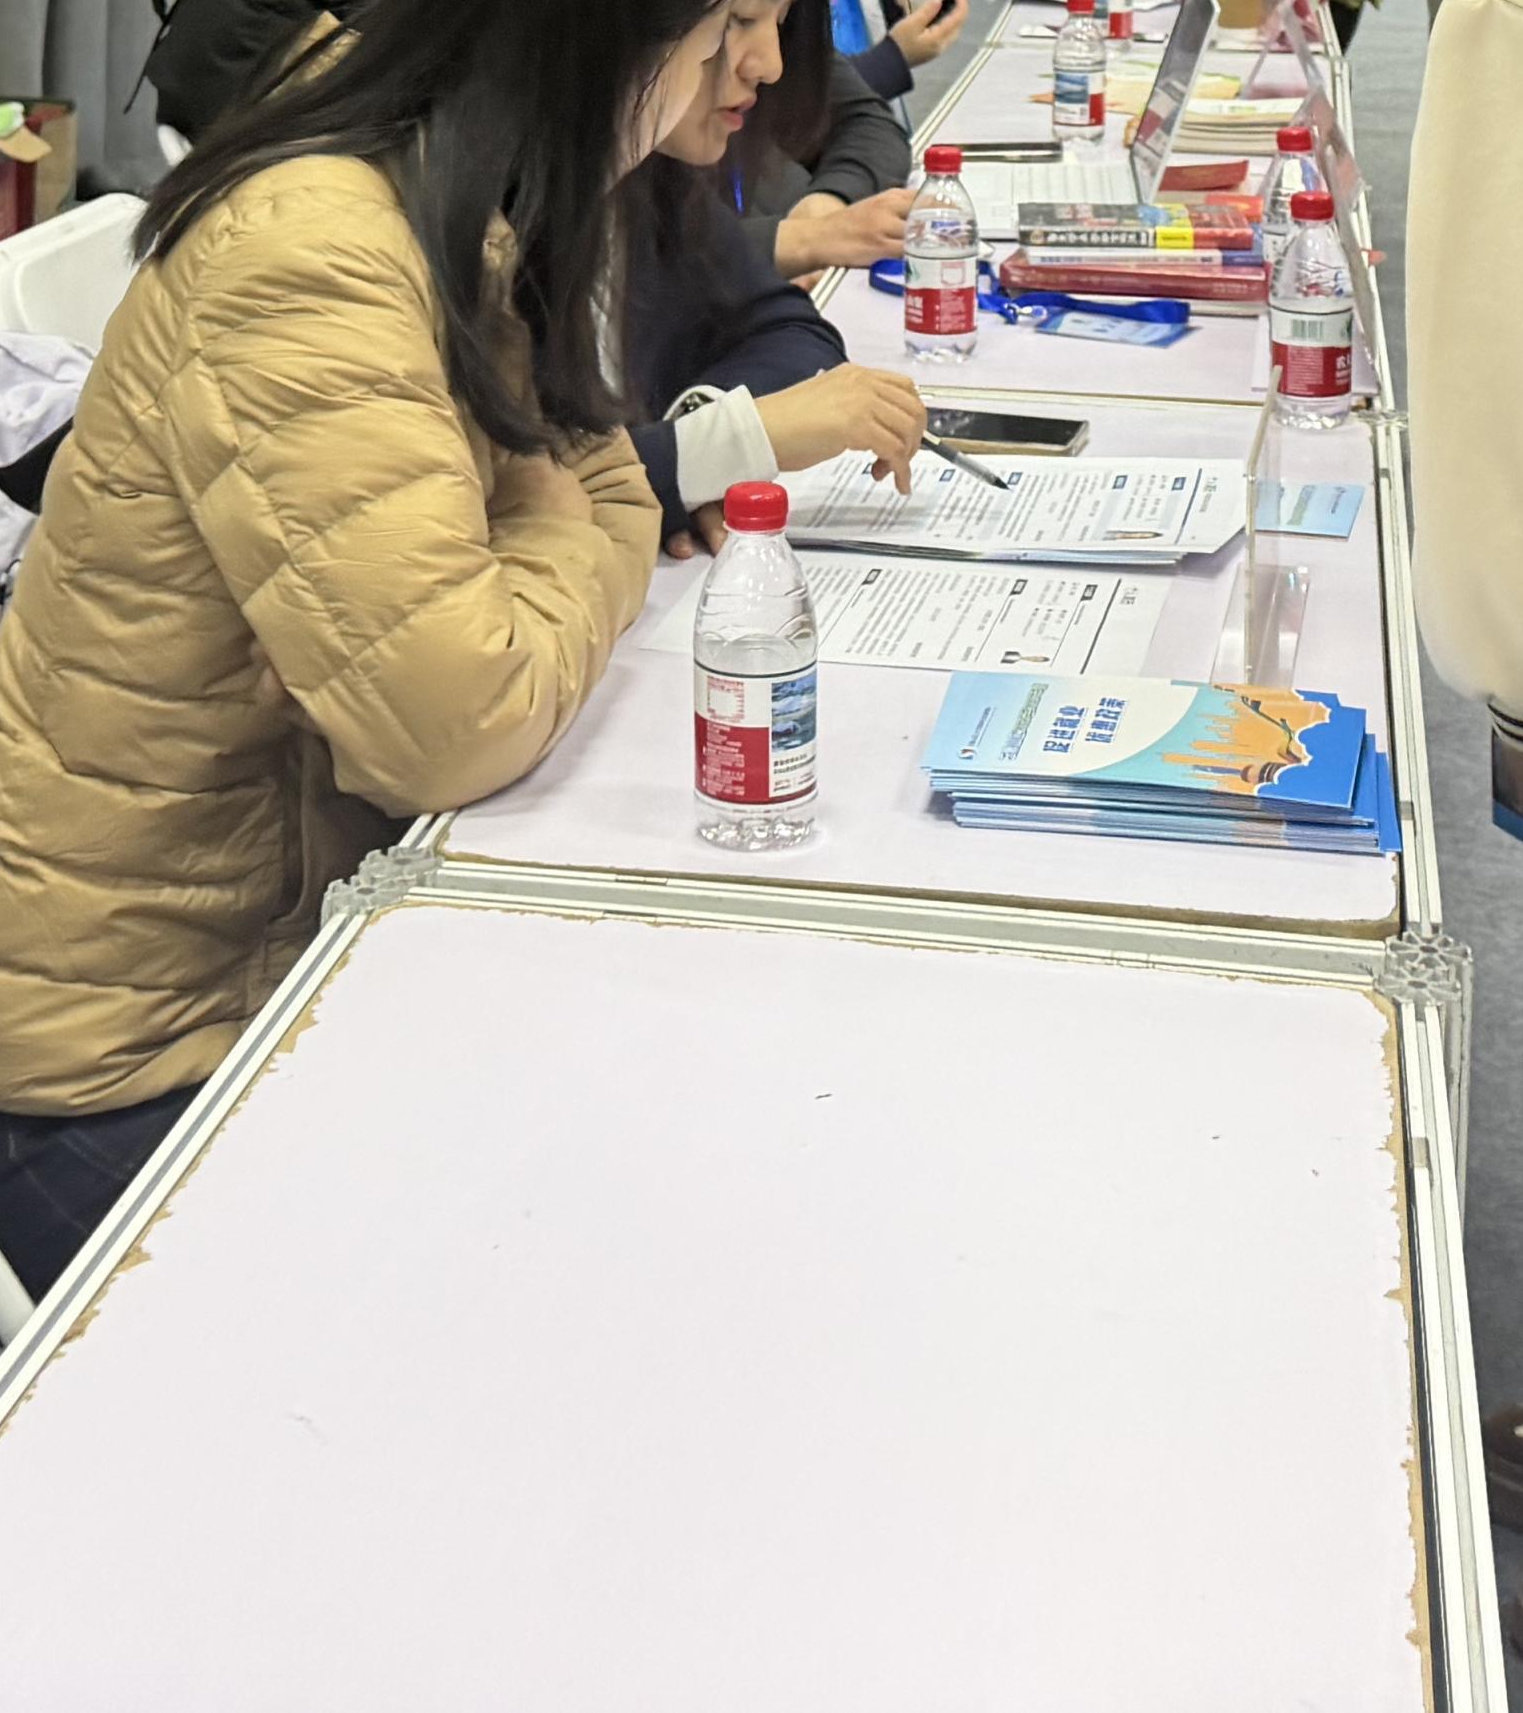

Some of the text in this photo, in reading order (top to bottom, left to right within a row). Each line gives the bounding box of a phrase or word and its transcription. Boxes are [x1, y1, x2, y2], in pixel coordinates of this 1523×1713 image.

[1042, 705, 1086, 753] 促进就业
[1085, 696, 1126, 744] 优惠政策
